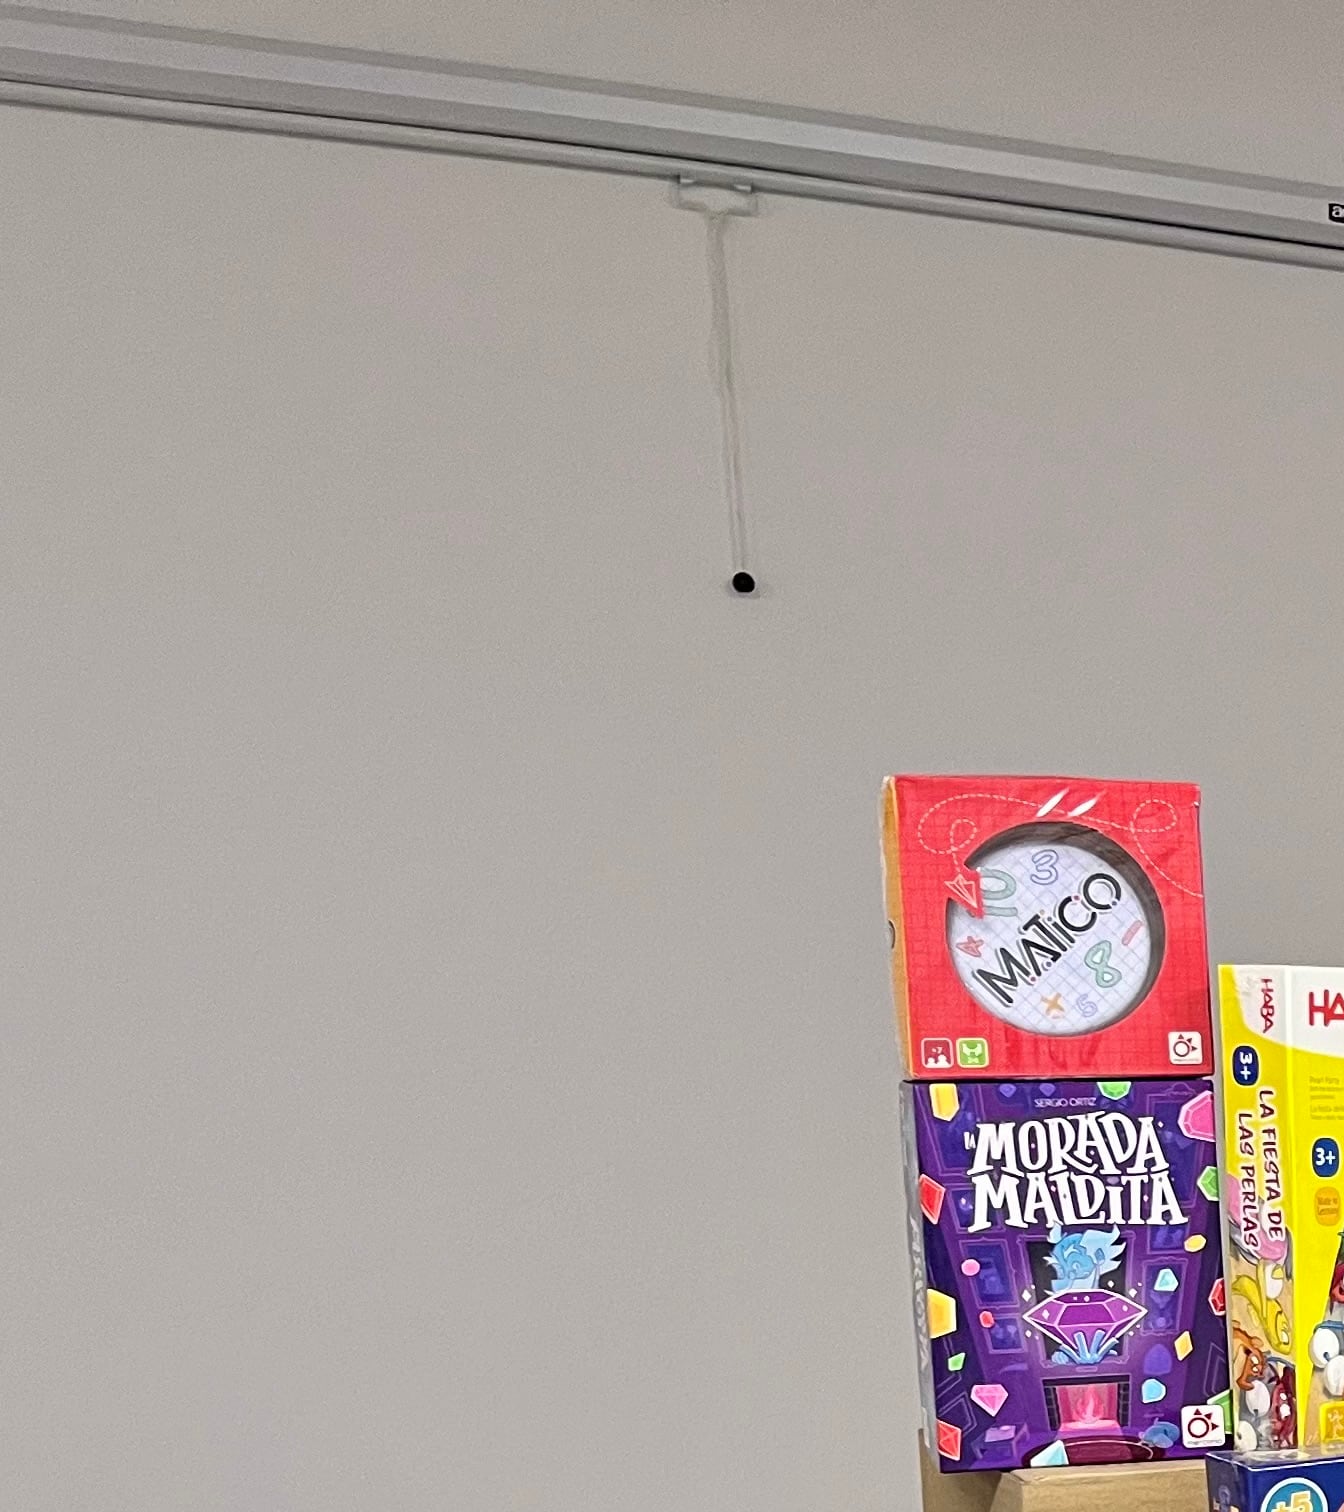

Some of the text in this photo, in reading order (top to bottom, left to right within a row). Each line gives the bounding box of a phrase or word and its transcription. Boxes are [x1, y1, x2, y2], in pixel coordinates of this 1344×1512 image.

[1260, 978, 1277, 1033] HABA
[967, 1111, 1169, 1176] MORADA
[1238, 1112, 1259, 1247] LAS PERLAS
[1259, 1089, 1284, 1242] LA FIESTA DE
